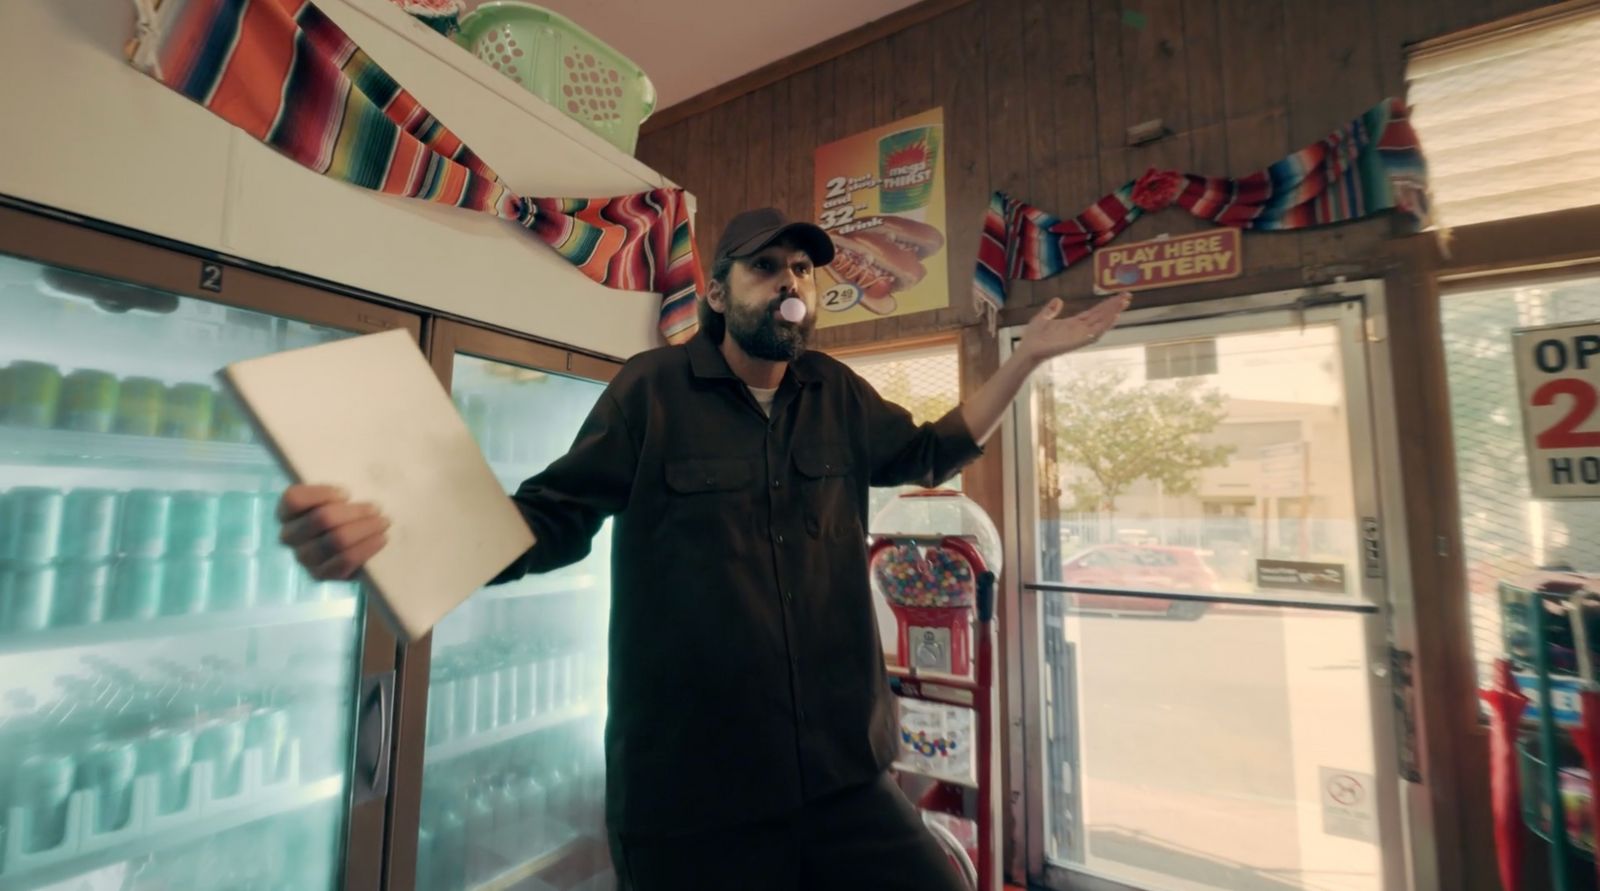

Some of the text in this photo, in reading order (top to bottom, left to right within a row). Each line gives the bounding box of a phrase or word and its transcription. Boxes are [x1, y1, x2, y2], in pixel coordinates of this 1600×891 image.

[884, 169, 931, 188] THIRST
[889, 161, 926, 176] mega
[823, 192, 852, 209] and
[826, 177, 847, 199] 2
[819, 205, 855, 229] 32
[839, 217, 883, 234] drink
[1109, 235, 1223, 267] PLAY HERE
[202, 265, 221, 291] 2
[1103, 252, 1231, 285] LOTTERY
[1535, 335, 1600, 374] OP
[1530, 378, 1600, 450] 2
[1549, 456, 1600, 485] HO
